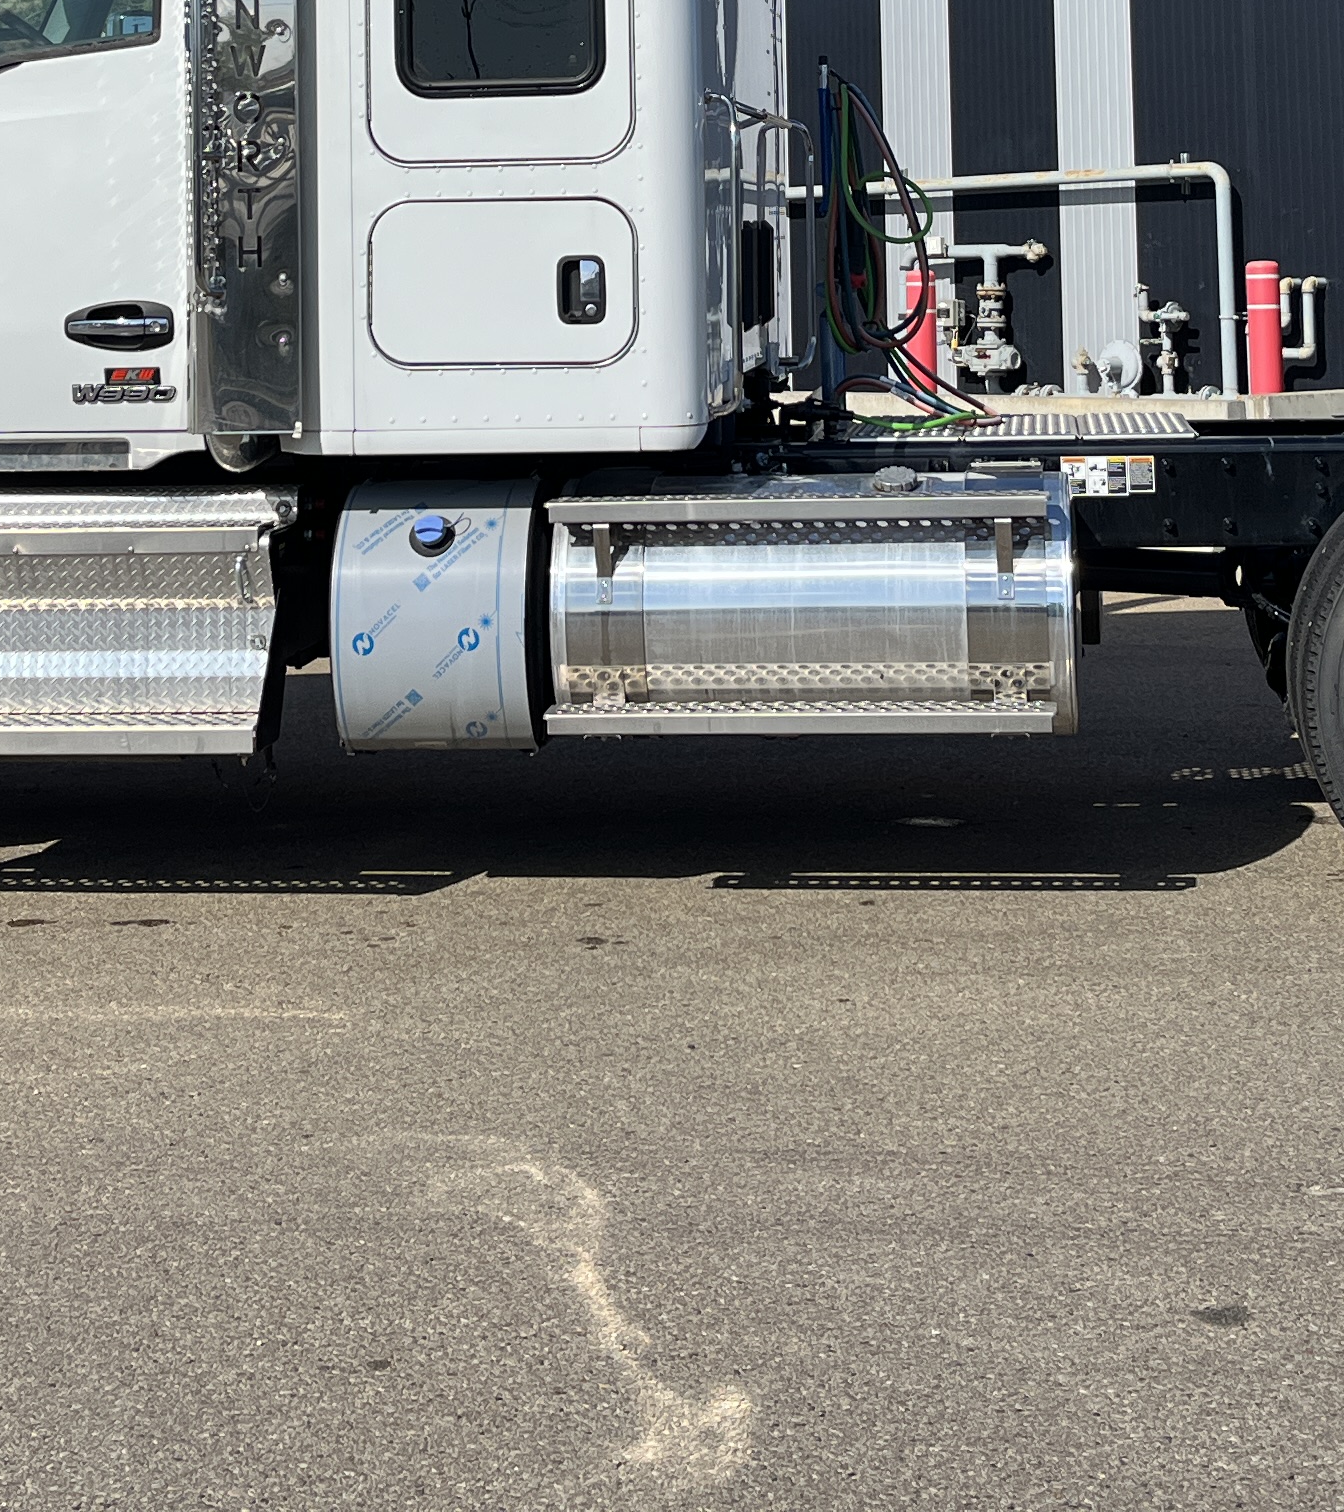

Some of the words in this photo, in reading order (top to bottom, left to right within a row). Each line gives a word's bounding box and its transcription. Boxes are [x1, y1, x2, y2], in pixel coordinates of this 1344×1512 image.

[72, 383, 178, 405] W990
[368, 603, 401, 635] NOVACEL
[432, 648, 465, 680] NOVACEL
